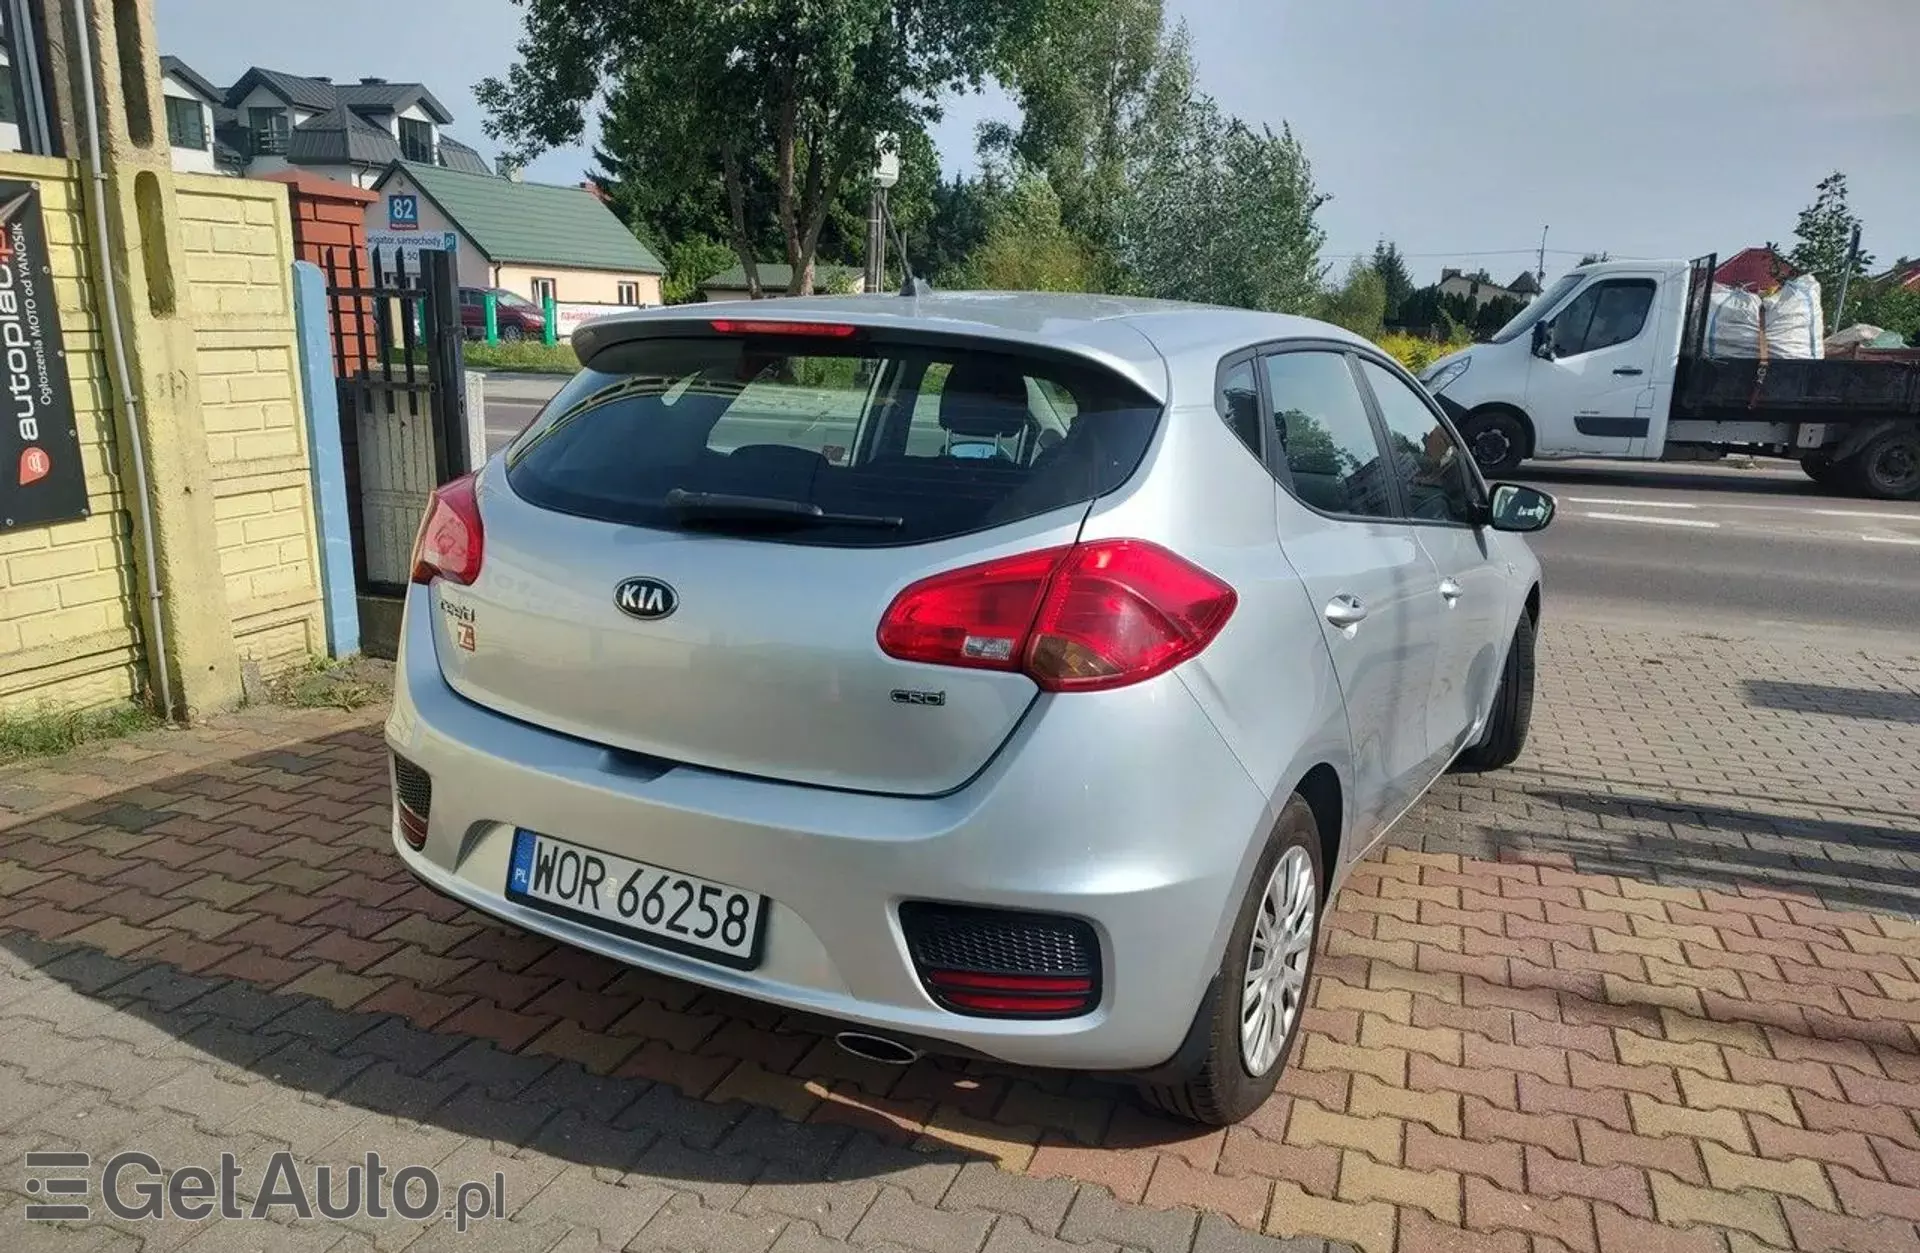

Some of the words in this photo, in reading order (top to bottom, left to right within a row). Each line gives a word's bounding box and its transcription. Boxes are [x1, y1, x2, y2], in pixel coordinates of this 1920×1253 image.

[393, 198, 415, 219] 82
[12, 222, 30, 278] YANOSIK
[21, 280, 34, 297] od
[25, 299, 42, 337] MOTO
[622, 584, 664, 611] KIA
[514, 867, 528, 884] PL
[532, 841, 606, 910] WOR
[616, 868, 750, 947] 66258
